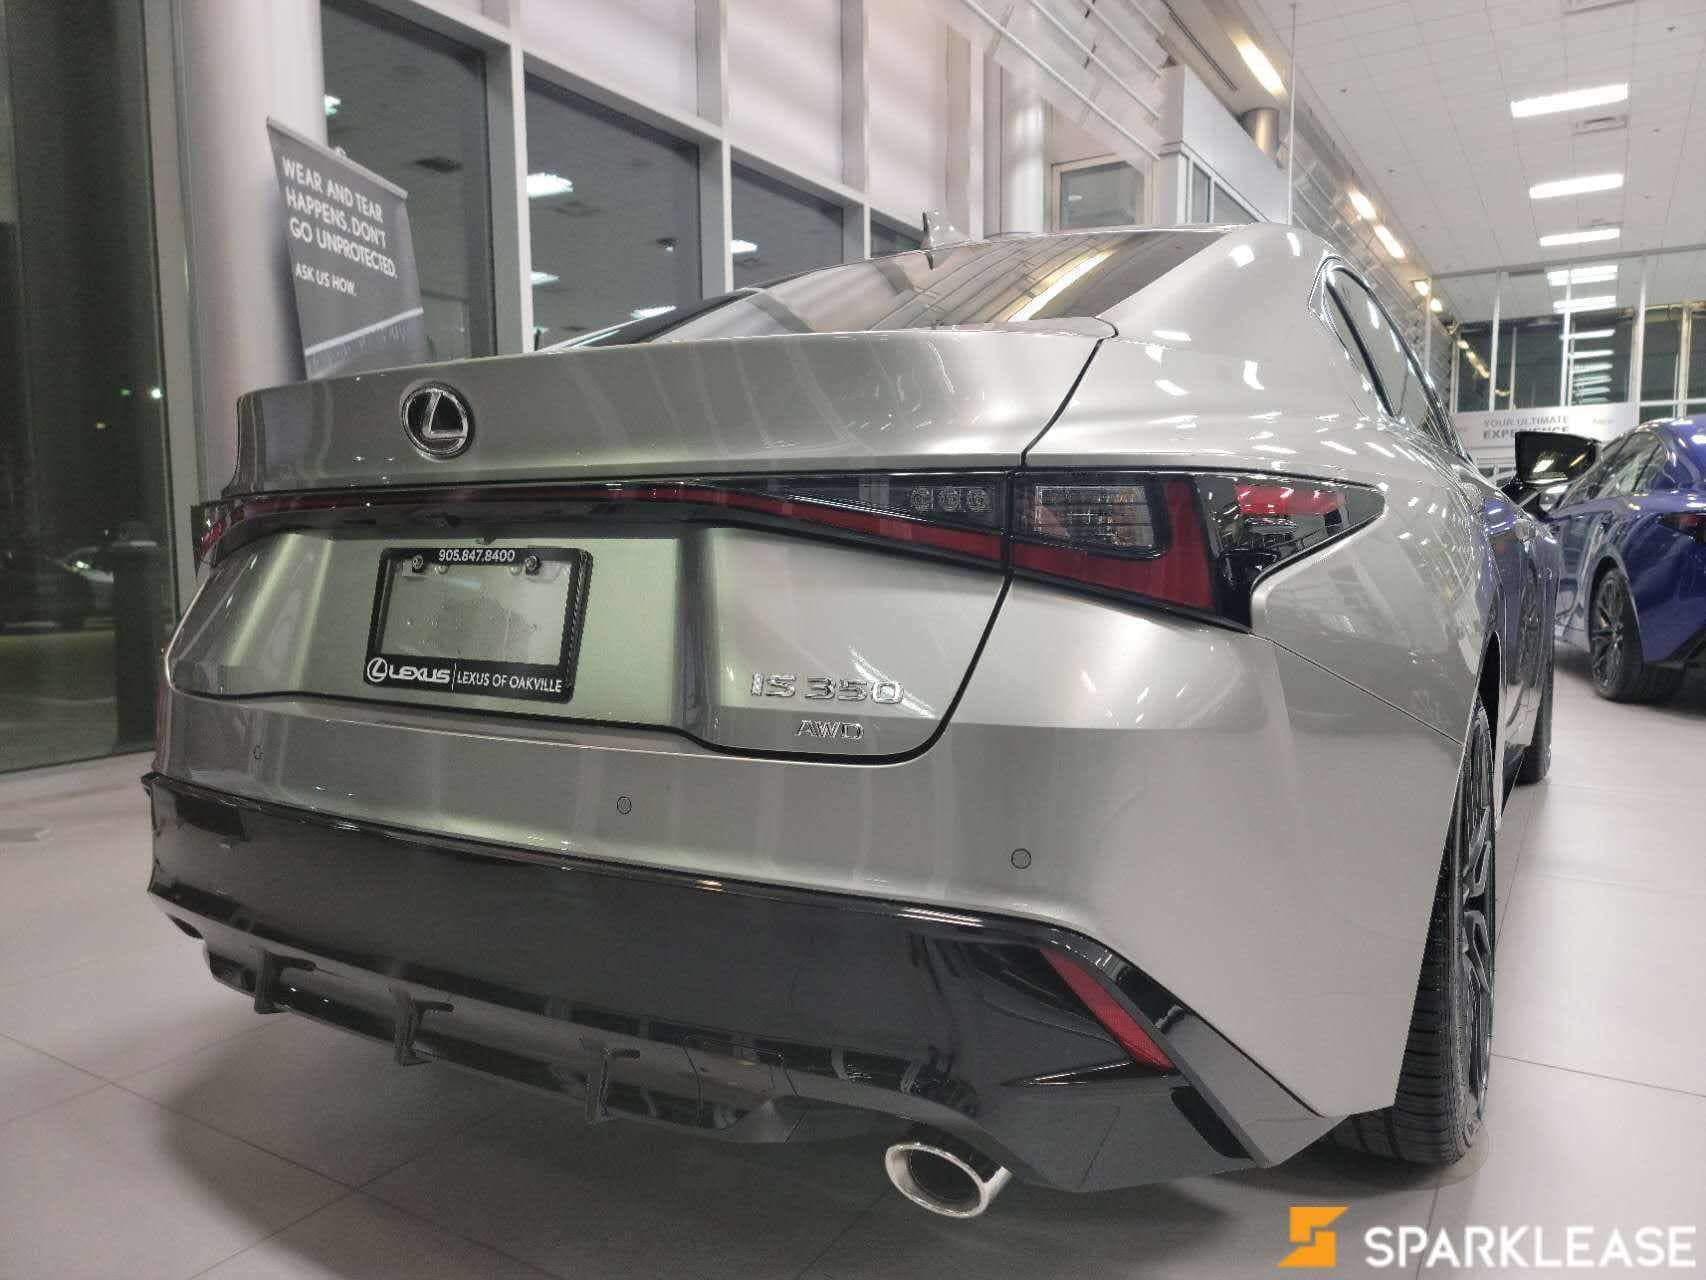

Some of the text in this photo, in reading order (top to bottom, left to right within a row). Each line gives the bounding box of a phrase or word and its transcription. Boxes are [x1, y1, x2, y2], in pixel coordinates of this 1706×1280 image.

[282, 156, 384, 224] WEAR AND TEAR
[285, 187, 387, 249] HAPPENS. DON'T
[289, 217, 399, 279] GO UNPROTECTED.
[295, 263, 357, 297] ASK US HOW.
[1483, 415, 1569, 427] YOUR ULTIMATE
[1483, 426, 1569, 440] EXPECE
[438, 550, 516, 563] 905.847.8400
[388, 665, 451, 684] LEXUS
[457, 672, 562, 694] LEXUS OF OAKVILLE
[751, 672, 905, 705] IS 350
[795, 719, 865, 741] AWD
